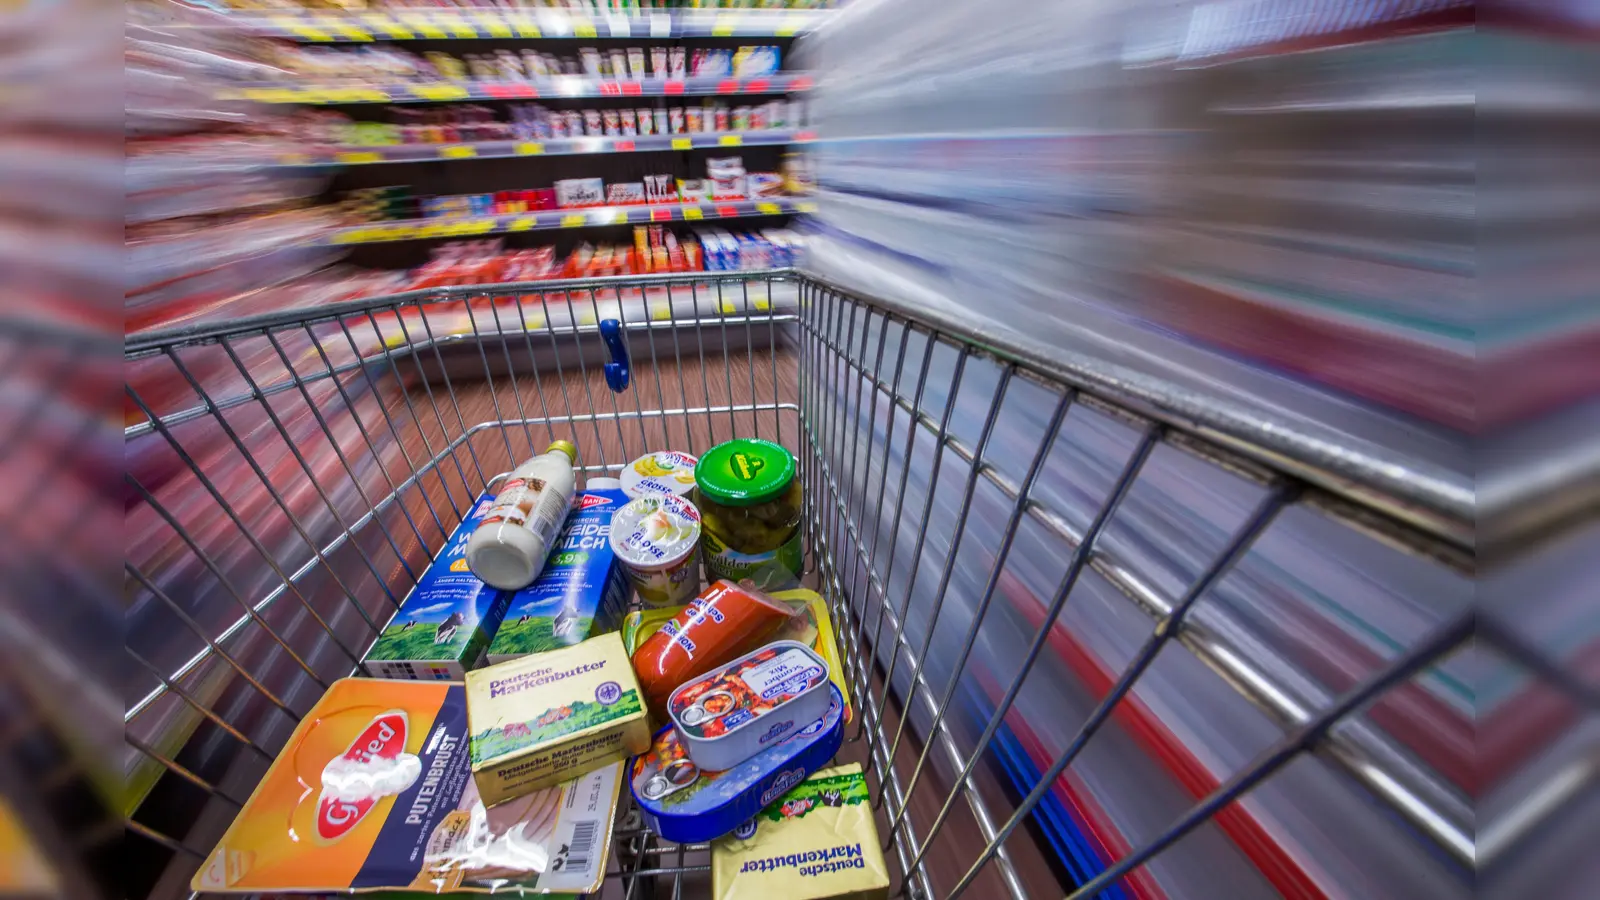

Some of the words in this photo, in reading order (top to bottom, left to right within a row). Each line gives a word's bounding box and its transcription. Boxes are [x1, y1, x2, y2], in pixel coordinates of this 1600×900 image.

[490, 666, 553, 690] Deutsche
[490, 660, 607, 699] Markenbutter
[764, 665, 804, 687] Scomber
[769, 664, 788, 675] Mix
[497, 755, 549, 778] Deutsche
[551, 731, 625, 759] Markenbutter
[405, 734, 459, 825] PUTENBRUST
[740, 842, 863, 874] Markenbutter
[800, 857, 865, 877] Deutsche
